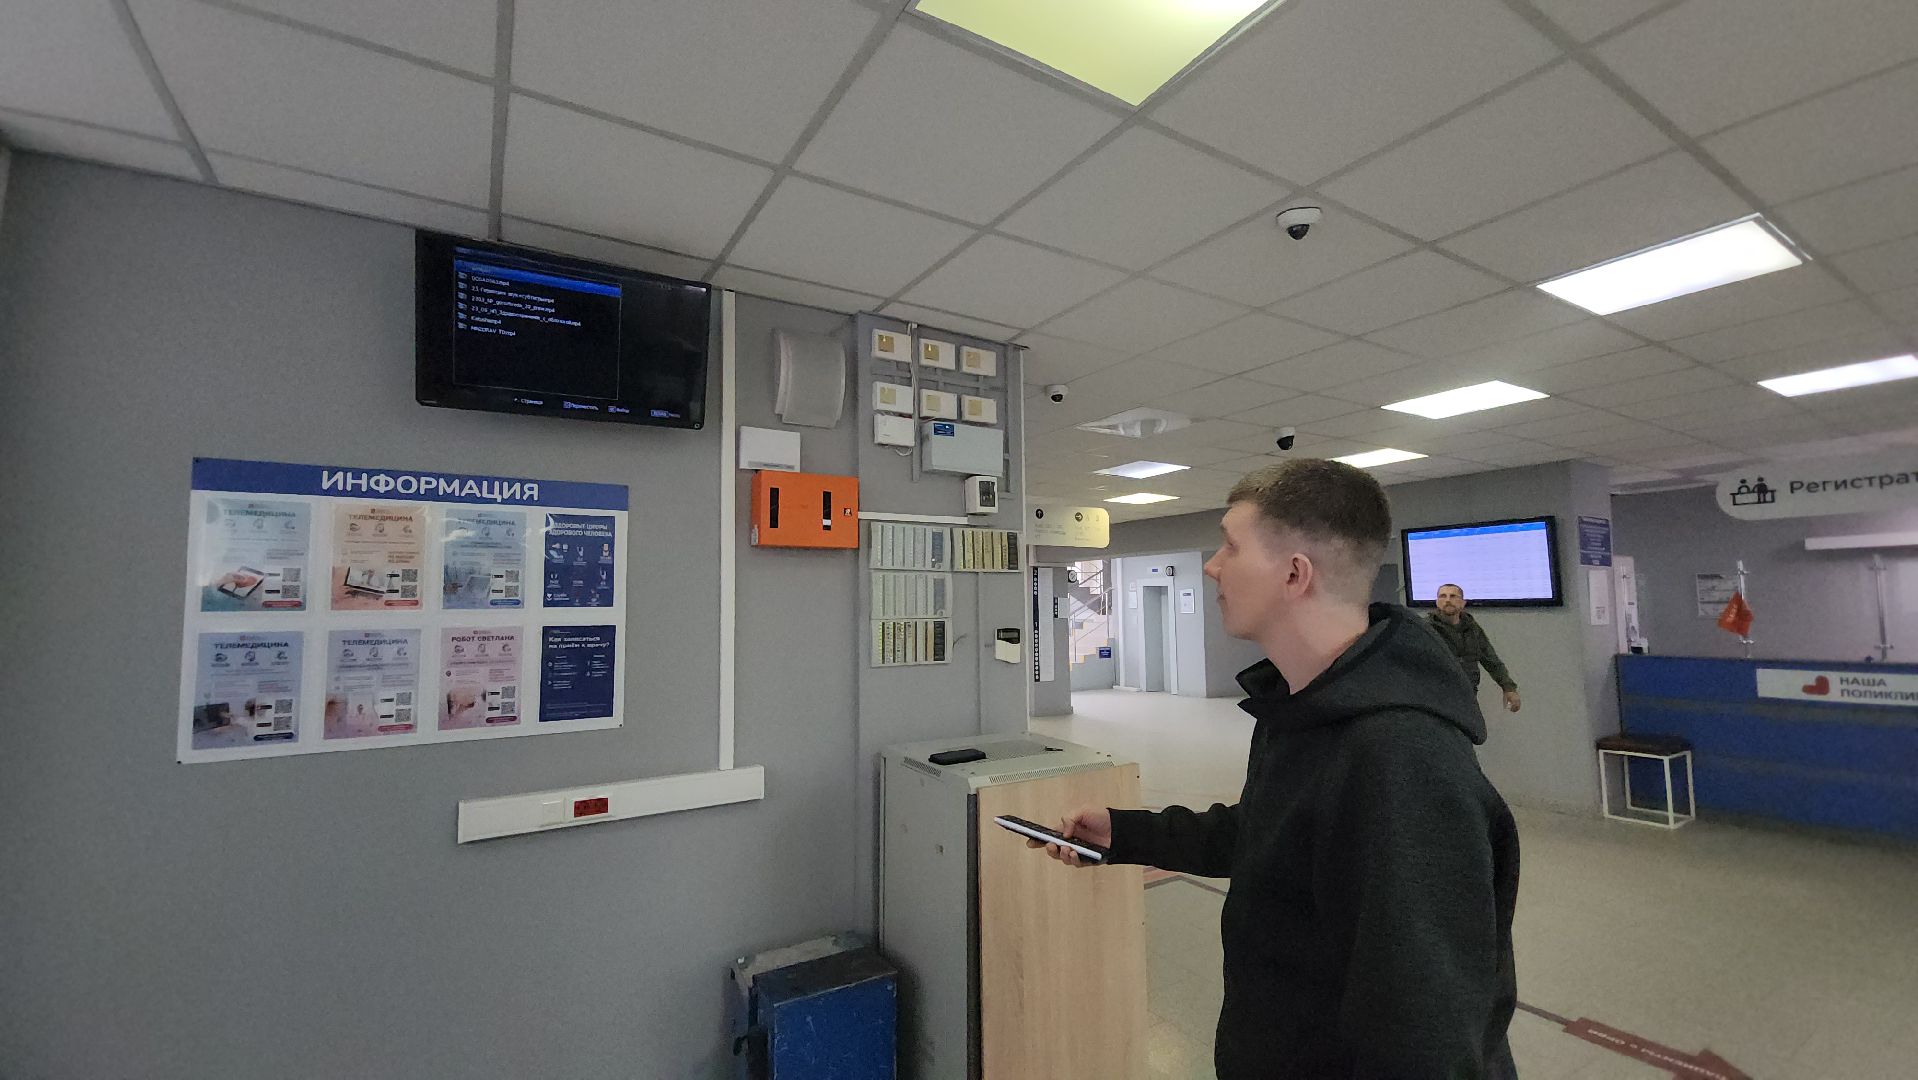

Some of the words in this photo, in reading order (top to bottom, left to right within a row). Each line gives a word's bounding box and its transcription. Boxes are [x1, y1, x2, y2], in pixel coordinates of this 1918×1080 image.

[321, 470, 540, 502] ИНФОРМАЦИЯ
[215, 641, 289, 650] ТЕЛЕМЕДИЦИНА
[1839, 676, 1888, 687] НАША
